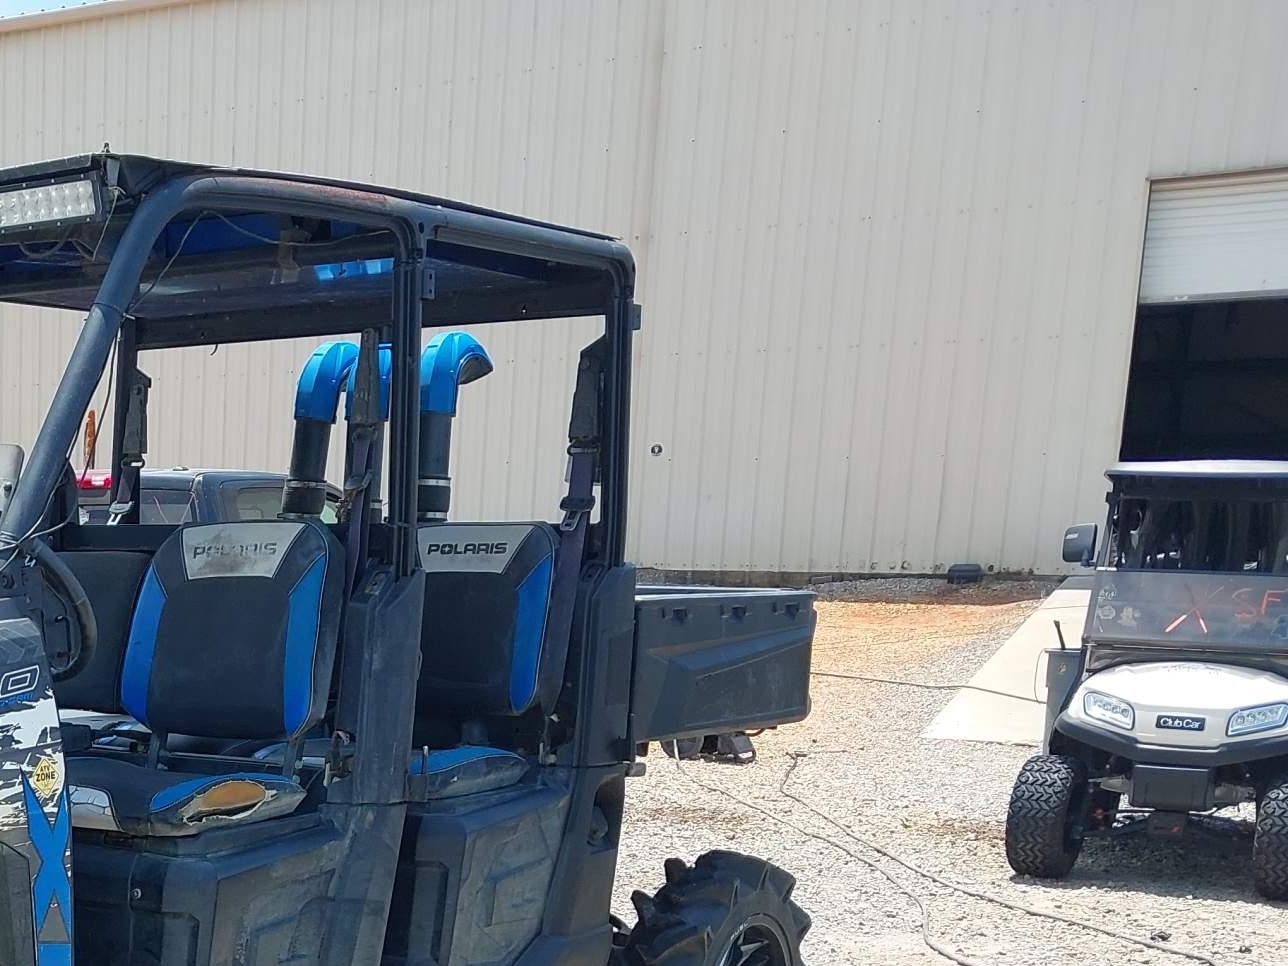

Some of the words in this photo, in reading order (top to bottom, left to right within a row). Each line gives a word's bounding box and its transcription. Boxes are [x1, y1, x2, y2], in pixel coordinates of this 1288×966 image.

[427, 542, 509, 555] POLARIS
[1160, 717, 1182, 727] Club
[1183, 719, 1201, 729] Car
[35, 771, 56, 782] ZONE
